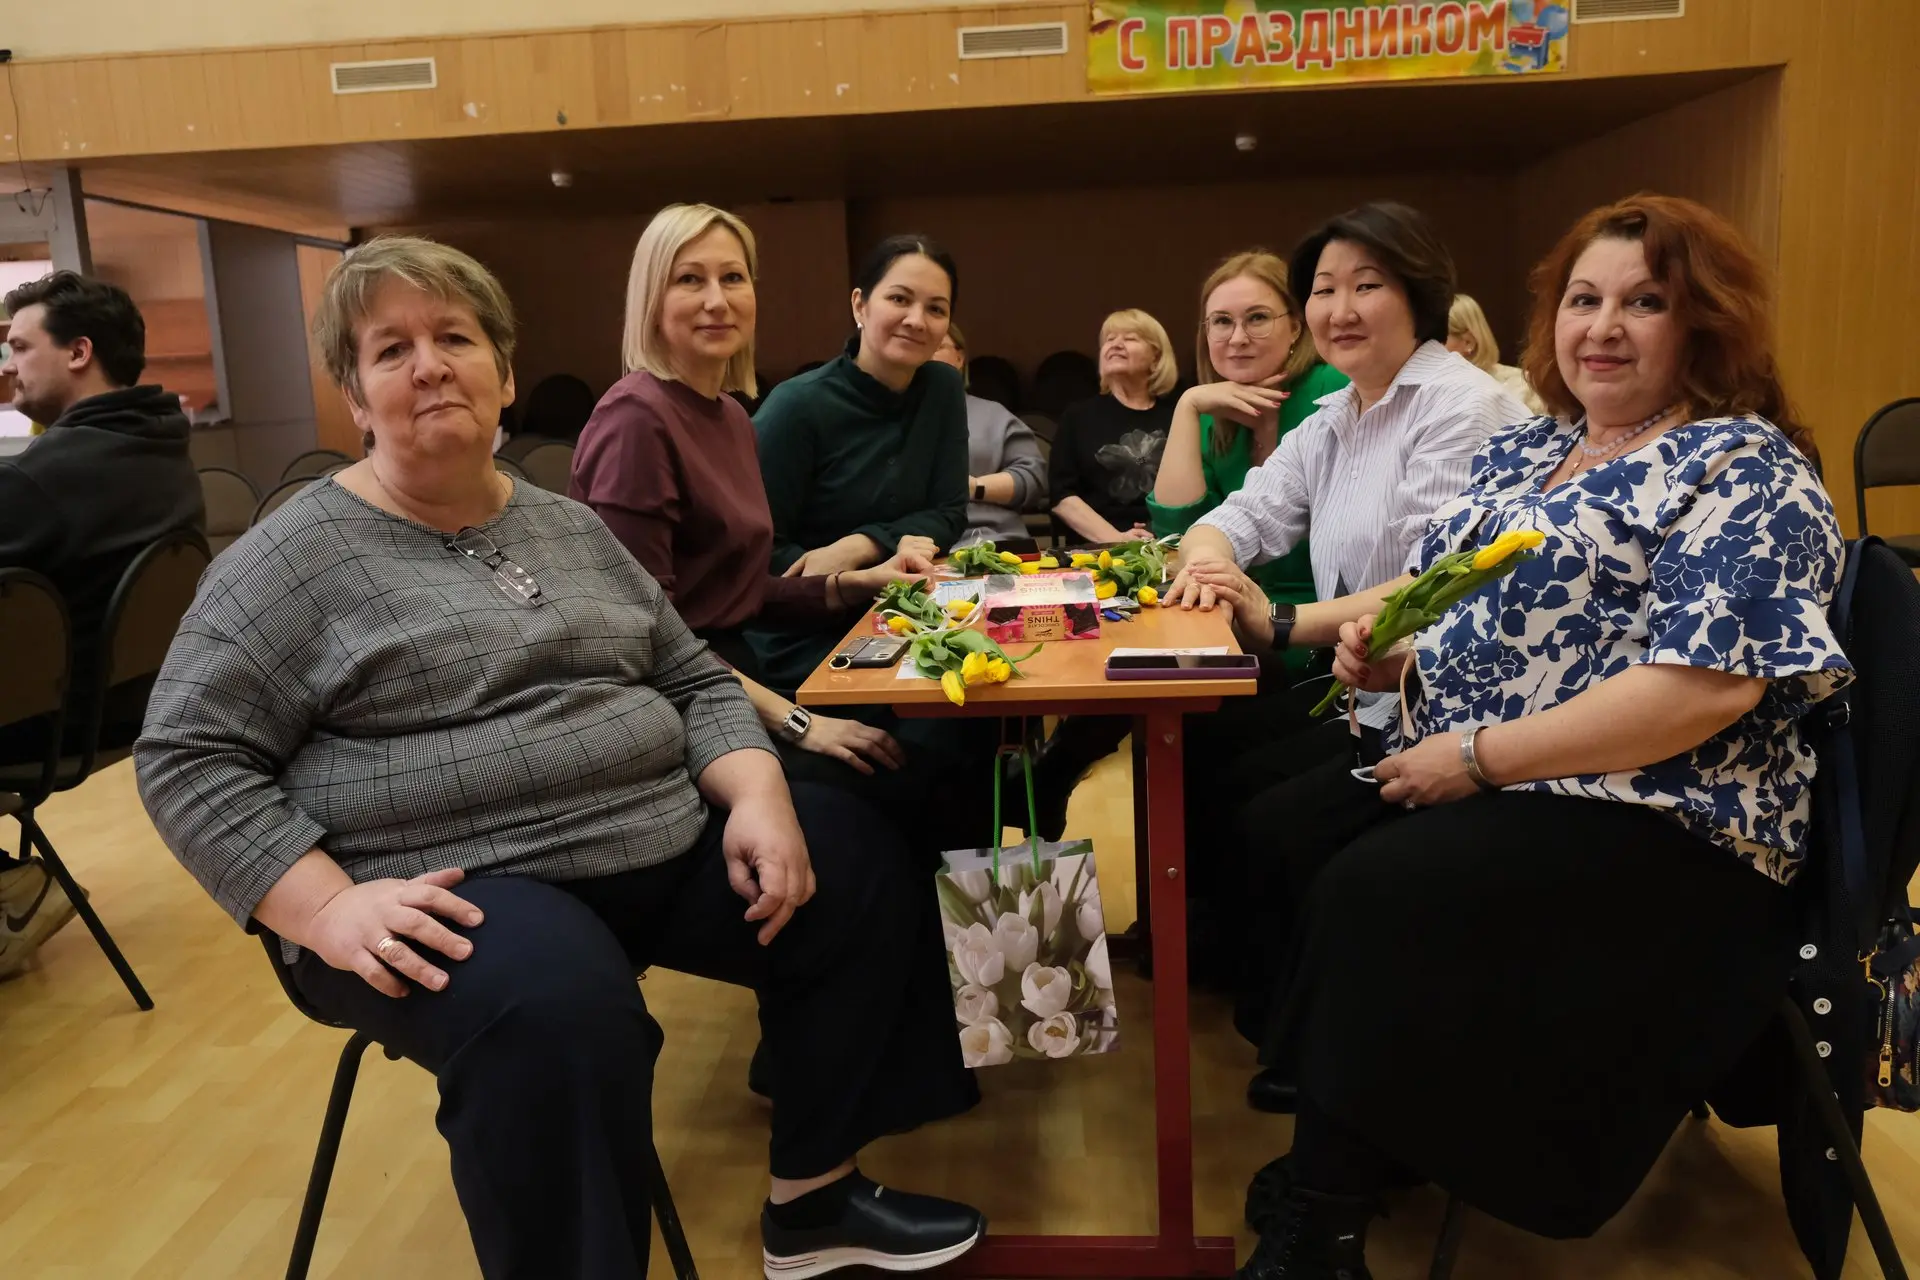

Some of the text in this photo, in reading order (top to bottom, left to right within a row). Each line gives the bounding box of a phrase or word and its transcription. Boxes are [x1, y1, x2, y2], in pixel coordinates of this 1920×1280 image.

[1119, 0, 1507, 71] С ПРАЗДНИКОМ
[1027, 616, 1060, 624] THINS
